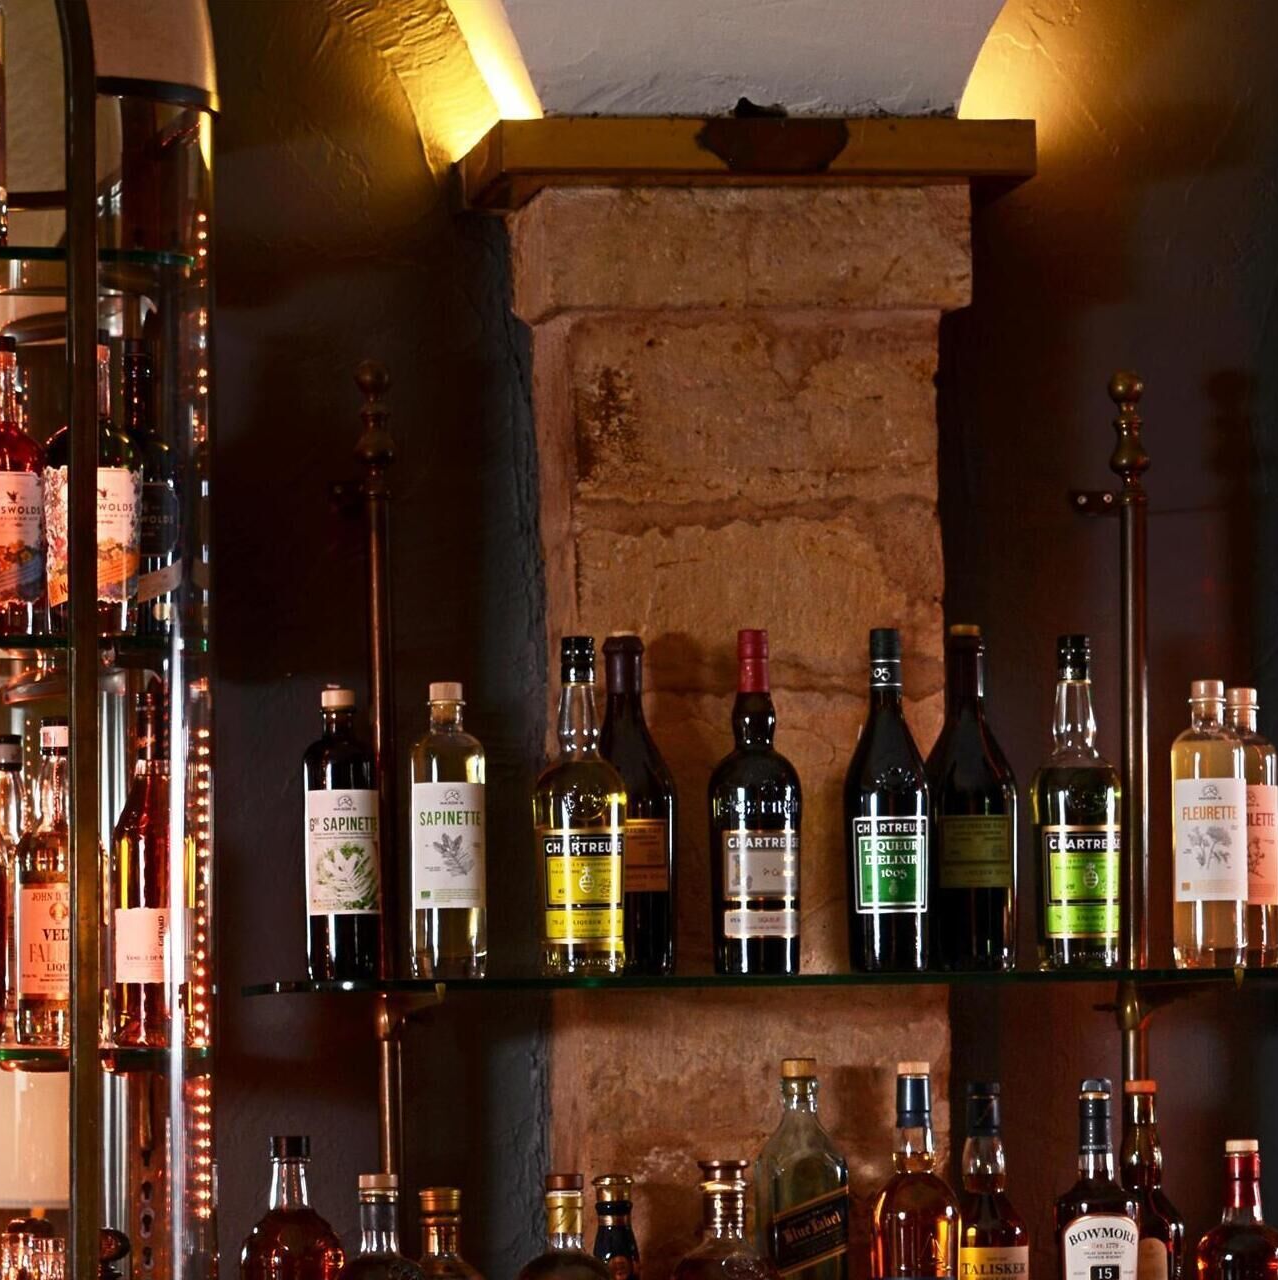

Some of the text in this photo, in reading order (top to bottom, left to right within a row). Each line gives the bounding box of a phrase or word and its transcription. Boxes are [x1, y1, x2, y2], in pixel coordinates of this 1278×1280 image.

[419, 810, 482, 827] SAPINETTE
[1182, 806, 1239, 821] FLEURETTE
[323, 816, 378, 832] SAPINETTE
[856, 823, 925, 834] CHRTREUSE
[545, 841, 623, 854] CHARTREUE
[727, 837, 799, 849] CHARTRESE
[863, 840, 919, 852] LQUEUR
[31, 892, 53, 902] JOHN
[42, 928, 69, 942] VEL
[46, 962, 69, 972] LIQU
[1068, 1226, 1136, 1247] BOWMORE
[961, 1262, 1026, 1276] TALISKER
[1097, 1267, 1113, 1280] 15
